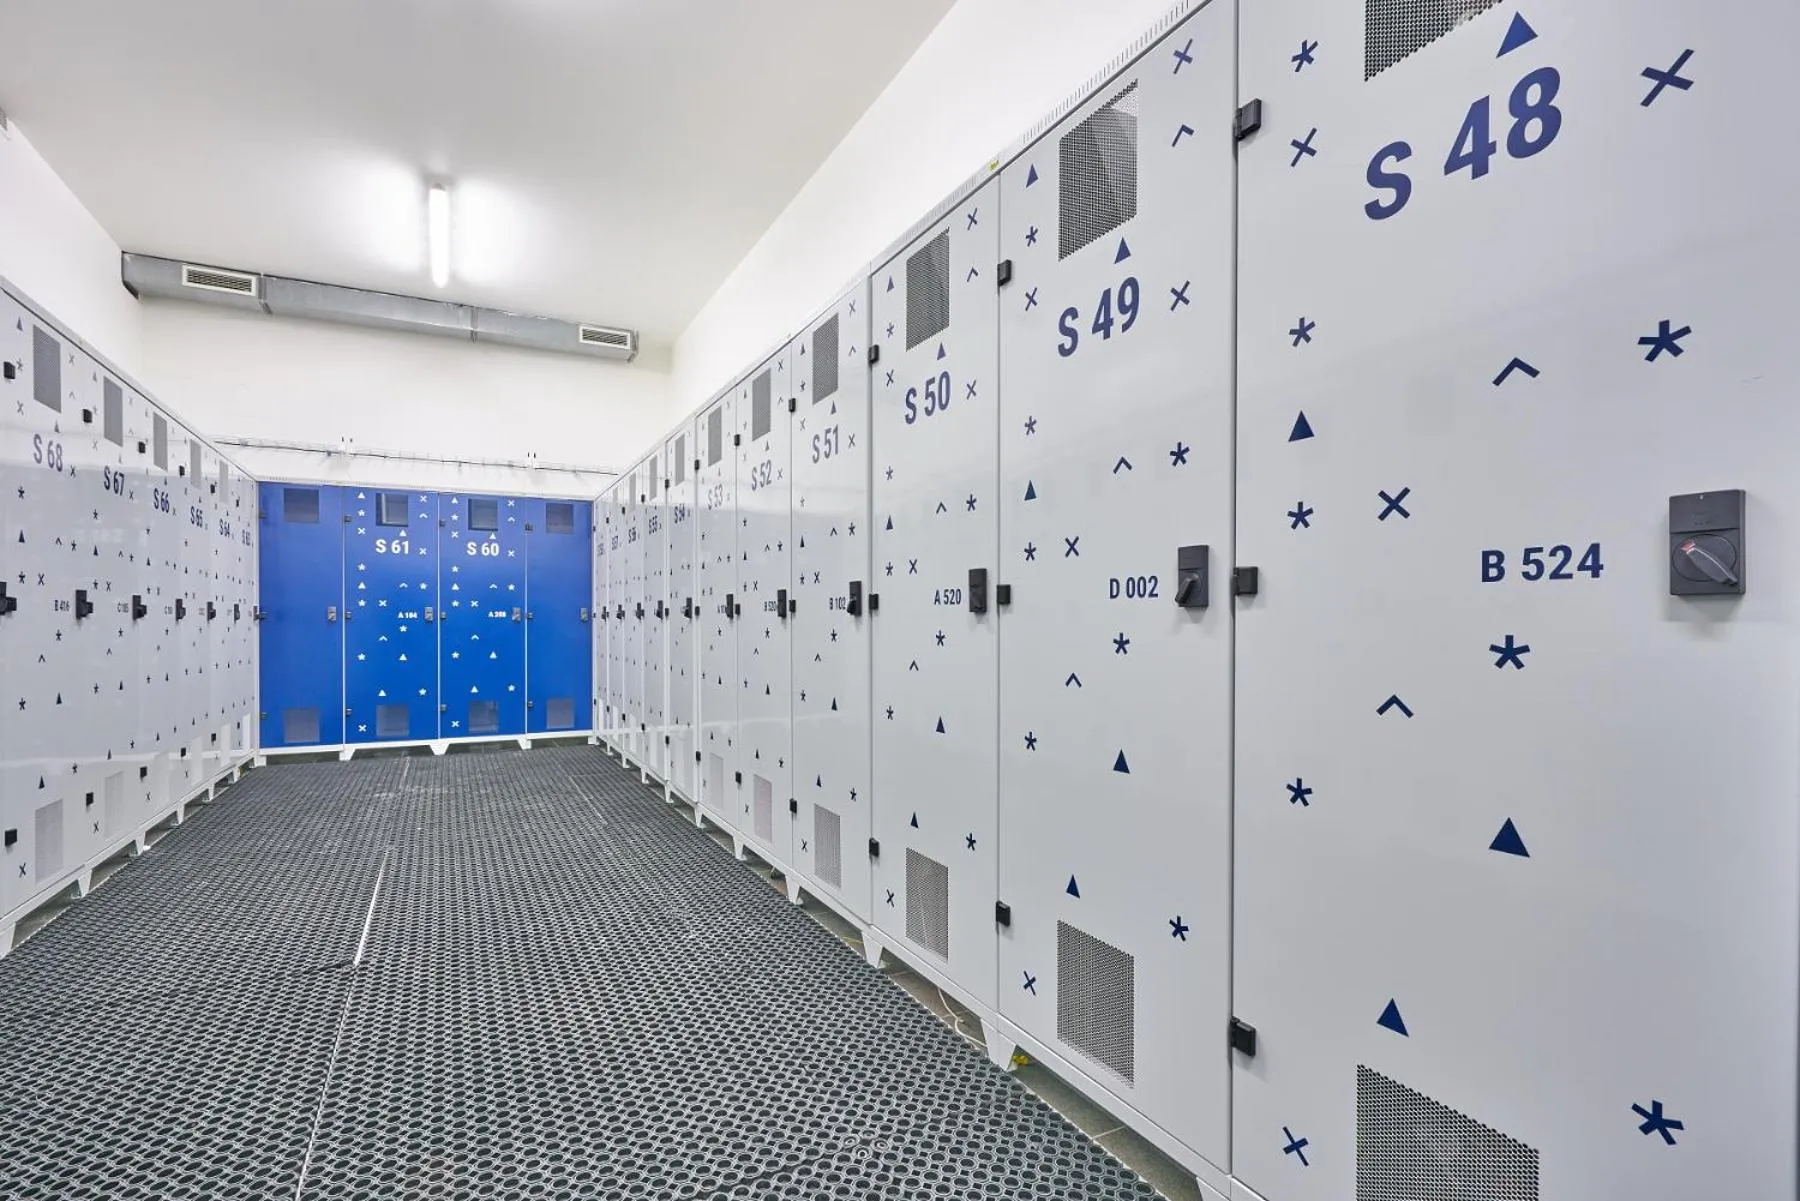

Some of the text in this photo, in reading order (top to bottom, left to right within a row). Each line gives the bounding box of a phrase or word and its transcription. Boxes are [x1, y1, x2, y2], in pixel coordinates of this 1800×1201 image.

[1364, 66, 1562, 220] S 48
[1057, 276, 1140, 357] S 49
[905, 370, 951, 424] S 50
[33, 434, 64, 472] S 68
[812, 424, 839, 464] S 51
[103, 466, 125, 496] S 67
[751, 459, 772, 491] S 52
[153, 488, 170, 514] S 66
[707, 484, 724, 511] S 53
[190, 505, 195, 524] S
[375, 539, 410, 554] S 61
[466, 542, 500, 557] S 60
[1481, 543, 1604, 583] B 524
[934, 588, 962, 605] A 520
[1109, 576, 1159, 599] D 002
[835, 596, 846, 610] 102
